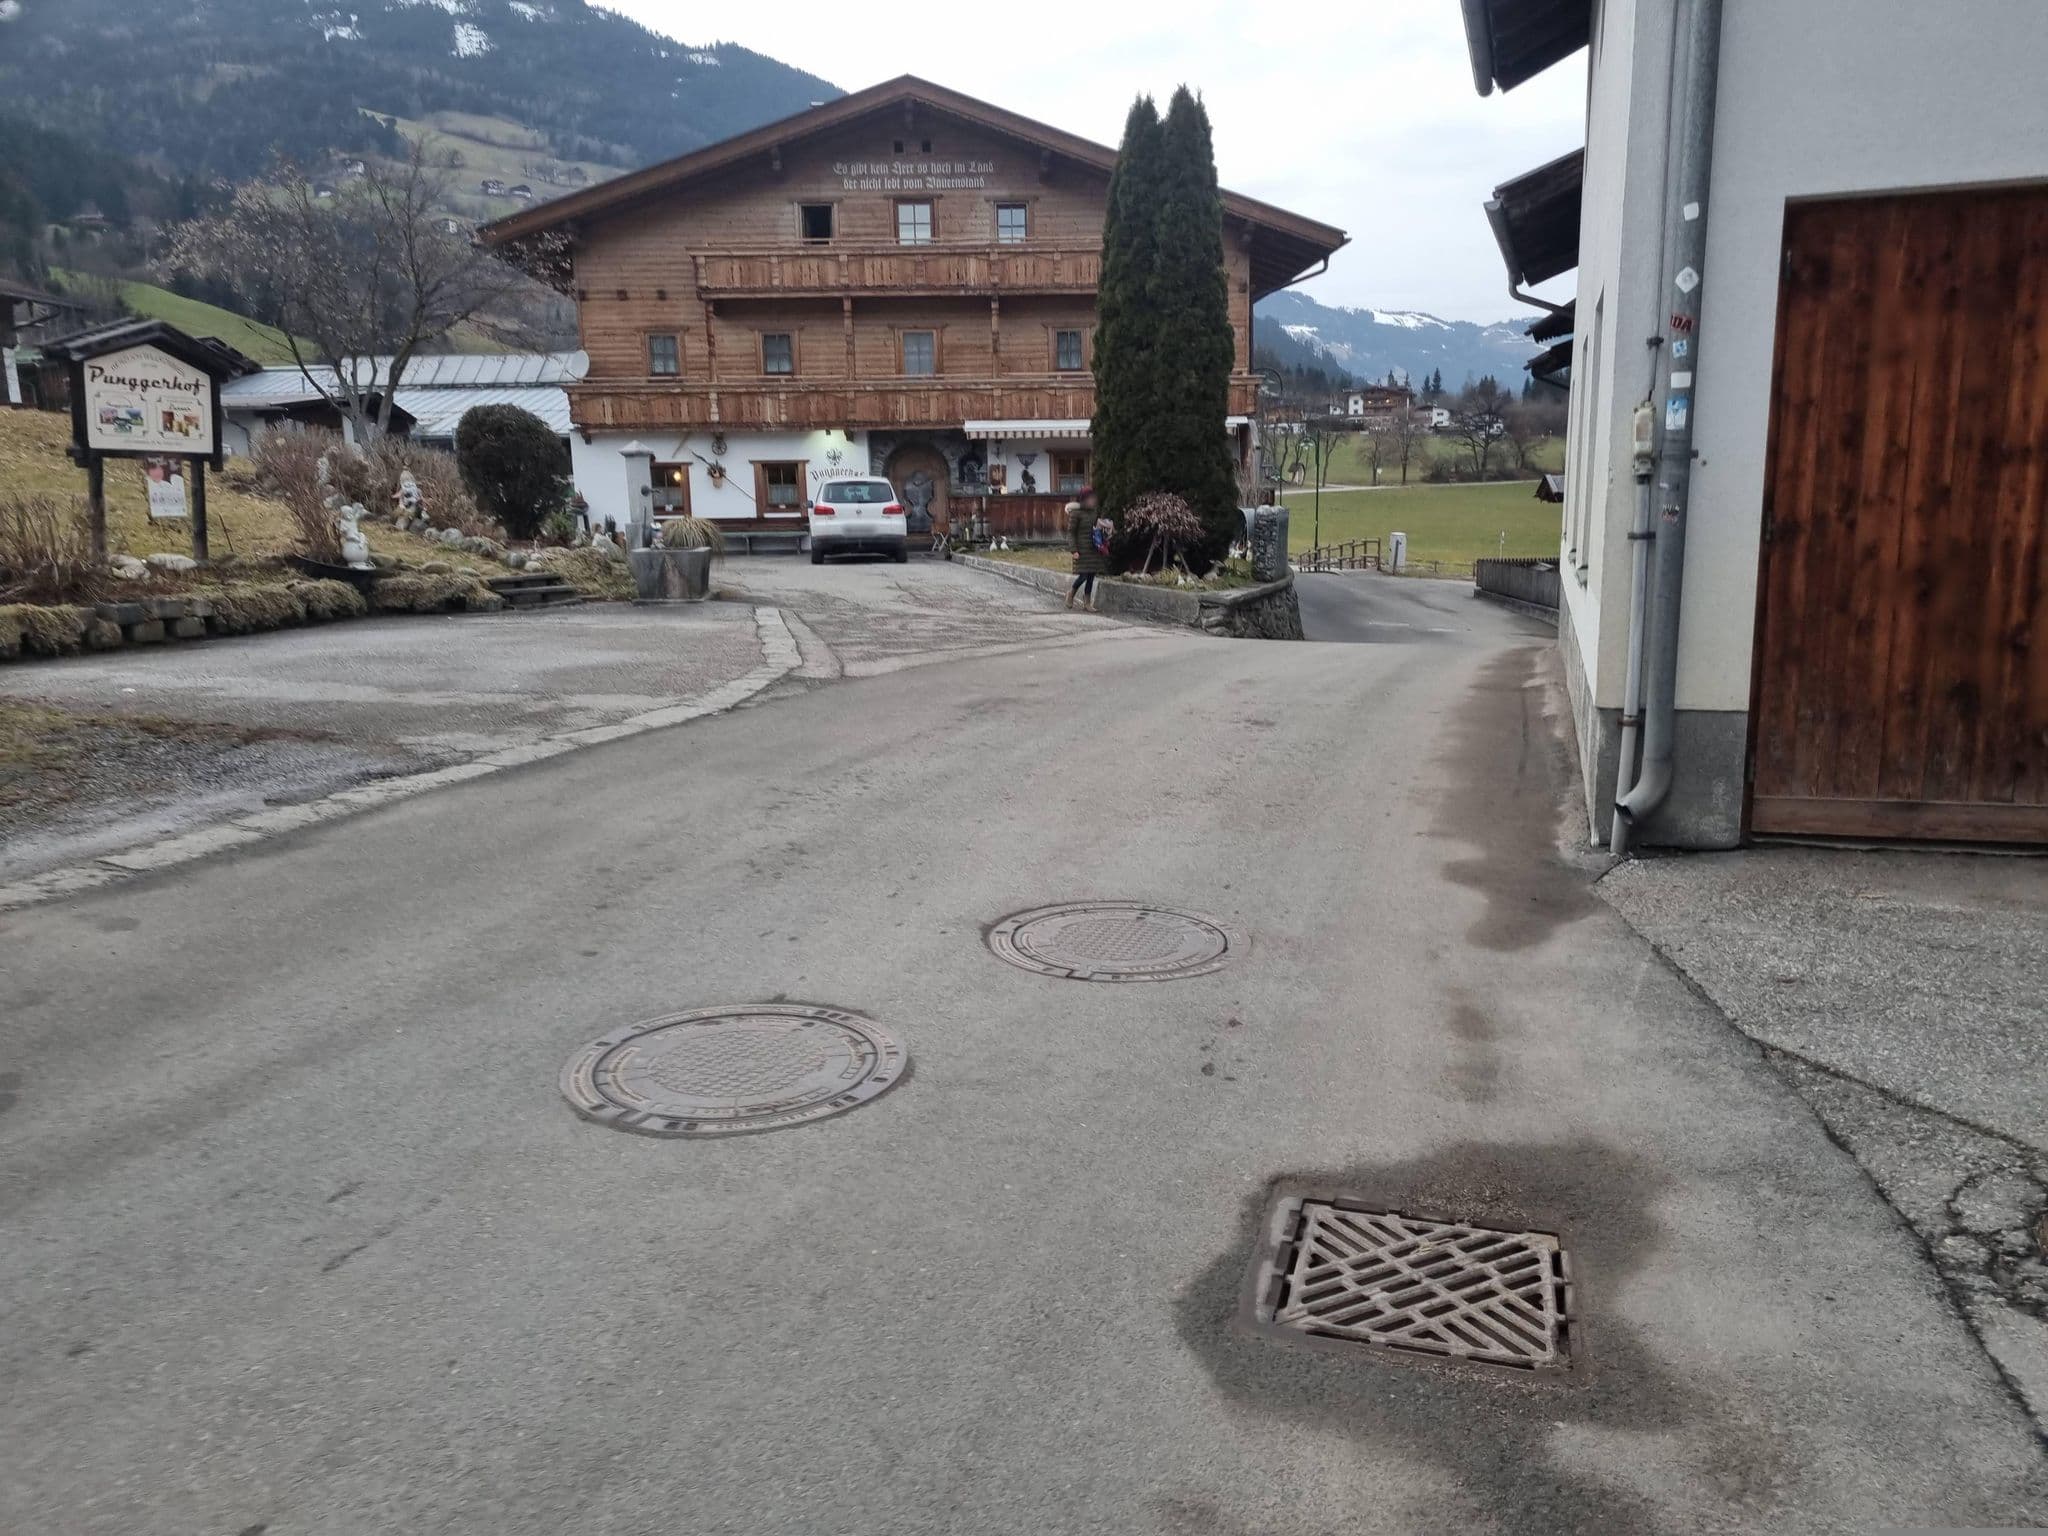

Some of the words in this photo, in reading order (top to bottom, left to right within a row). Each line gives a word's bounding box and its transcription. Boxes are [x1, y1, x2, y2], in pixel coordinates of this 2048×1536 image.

[851, 162, 867, 176] gibt
[870, 162, 889, 175] kein
[917, 163, 928, 174] so
[931, 162, 951, 176] hoch
[954, 162, 966, 174] im
[968, 161, 994, 174] Land
[843, 177, 858, 190] der
[860, 177, 882, 191] nicht
[884, 177, 901, 190] lebt
[903, 178, 923, 190] vom
[926, 176, 985, 191] Bauernstand
[88, 364, 206, 396] Punggerhof
